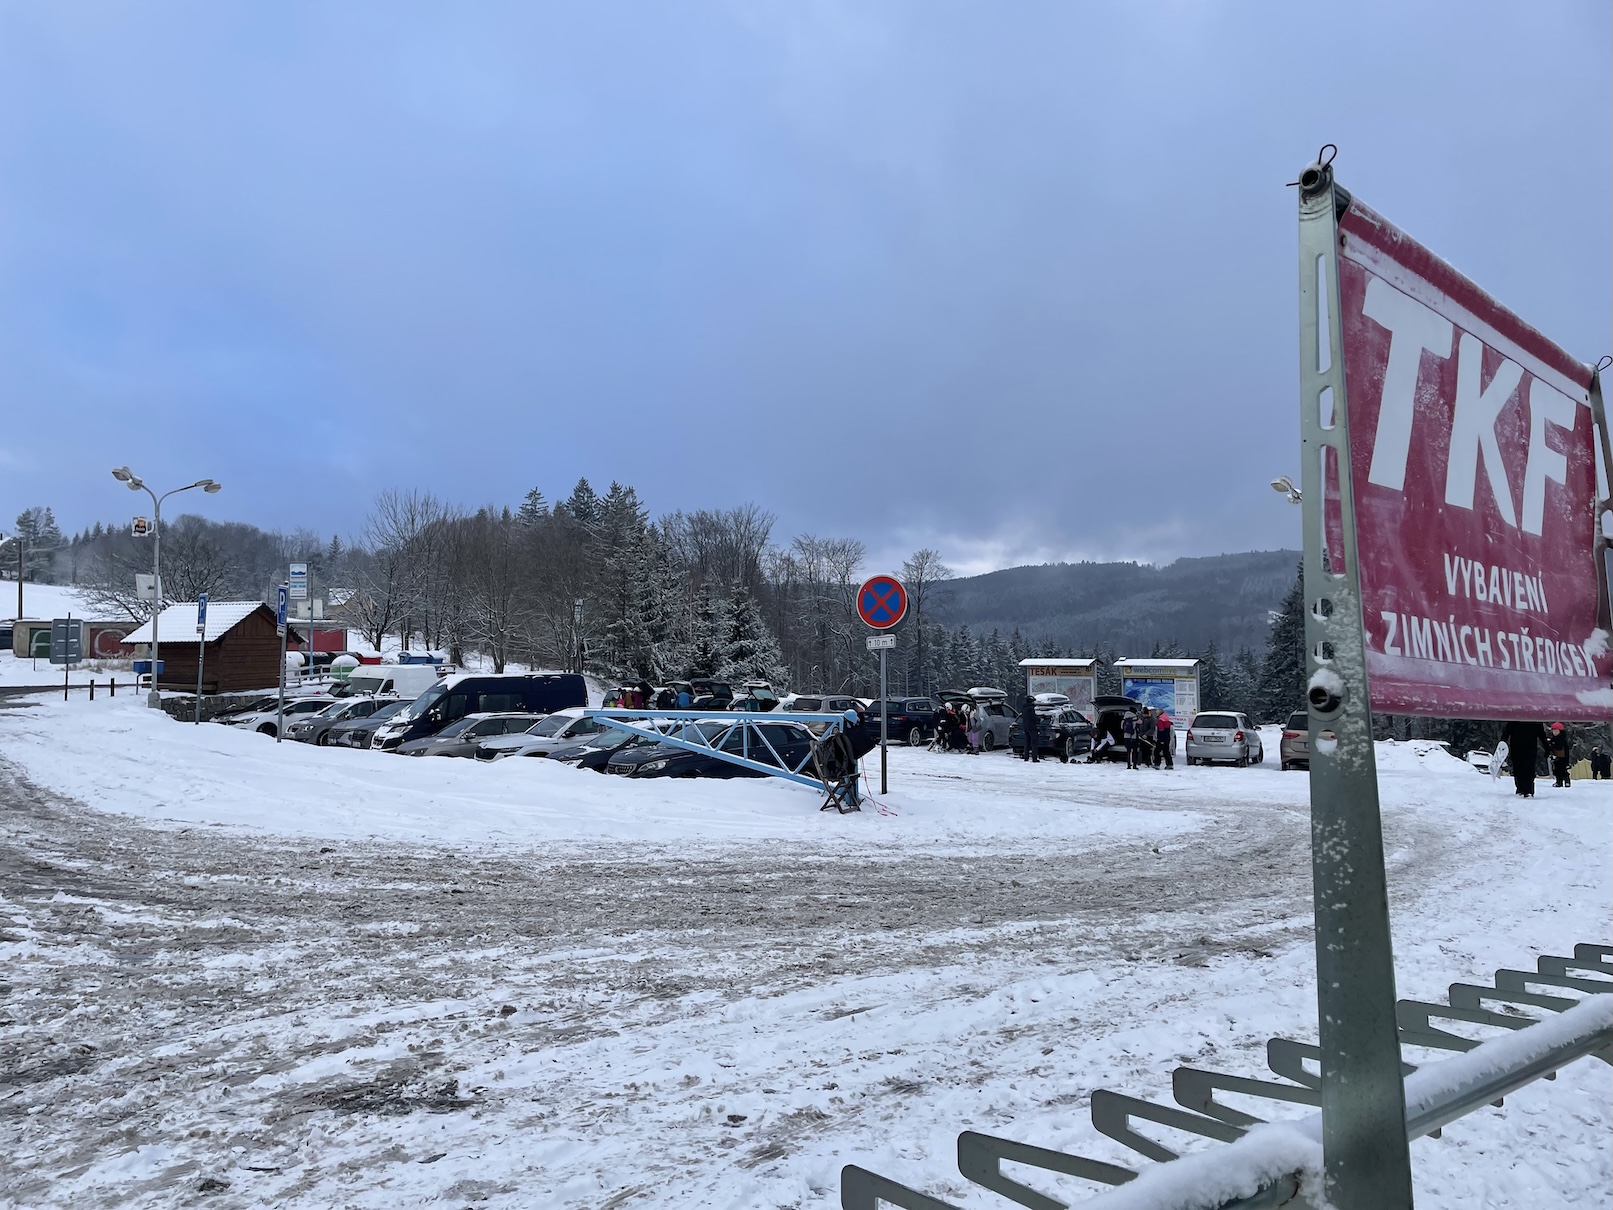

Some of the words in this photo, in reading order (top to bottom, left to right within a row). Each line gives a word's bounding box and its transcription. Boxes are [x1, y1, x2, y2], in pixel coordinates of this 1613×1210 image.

[1362, 277, 1577, 536] TKF
[1444, 552, 1549, 614] VYBAVENÍ
[1030, 666, 1057, 676] TESÁK
[1380, 611, 1494, 667] ZIMNÍCH
[1496, 626, 1598, 678] STŘEDISEK
